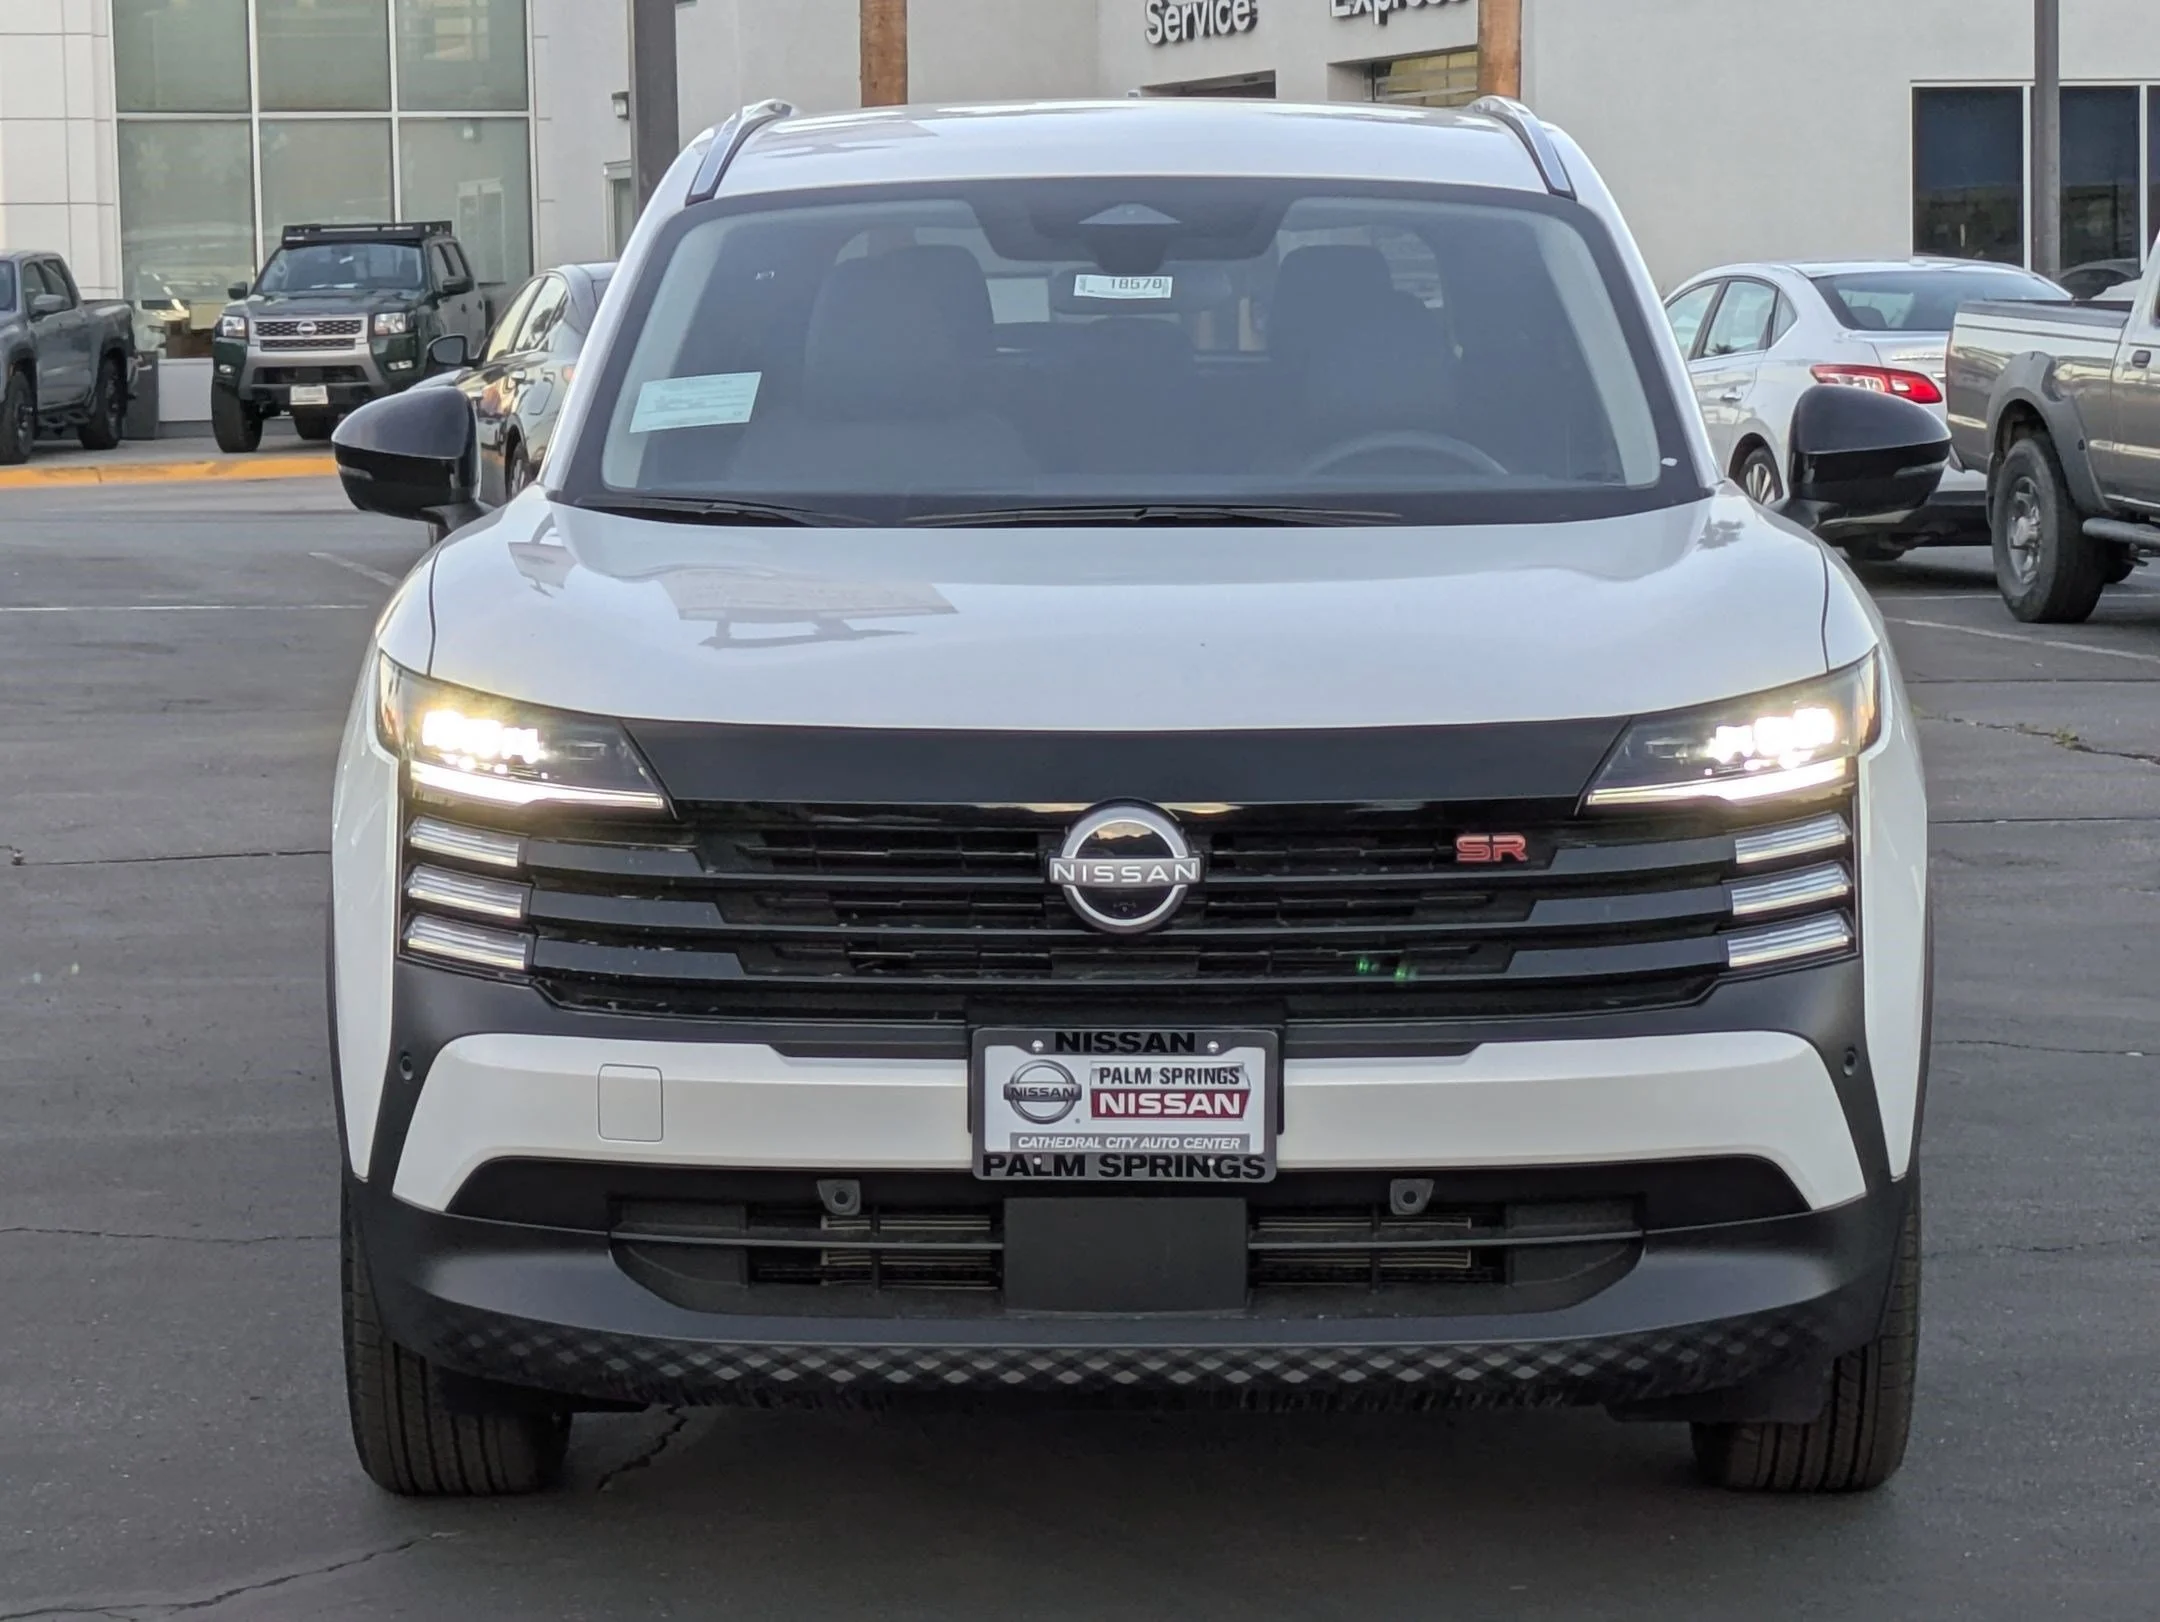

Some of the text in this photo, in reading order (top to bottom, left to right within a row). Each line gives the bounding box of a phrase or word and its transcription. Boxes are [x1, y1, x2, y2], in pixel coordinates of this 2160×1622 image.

[1145, 0, 1251, 45] Service
[1456, 835, 1528, 861] SR
[1053, 862, 1197, 883] NISSAN
[1055, 1031, 1196, 1053] NISSAN
[1099, 1067, 1240, 1085] PALM SPRINGS
[1010, 1086, 1075, 1098] NISSAN
[1099, 1092, 1241, 1115] NISSAN
[1018, 1136, 1241, 1150] CATHEDRAL CITY AUTO CENTER
[982, 1154, 1266, 1180] PALM SPRINGS
